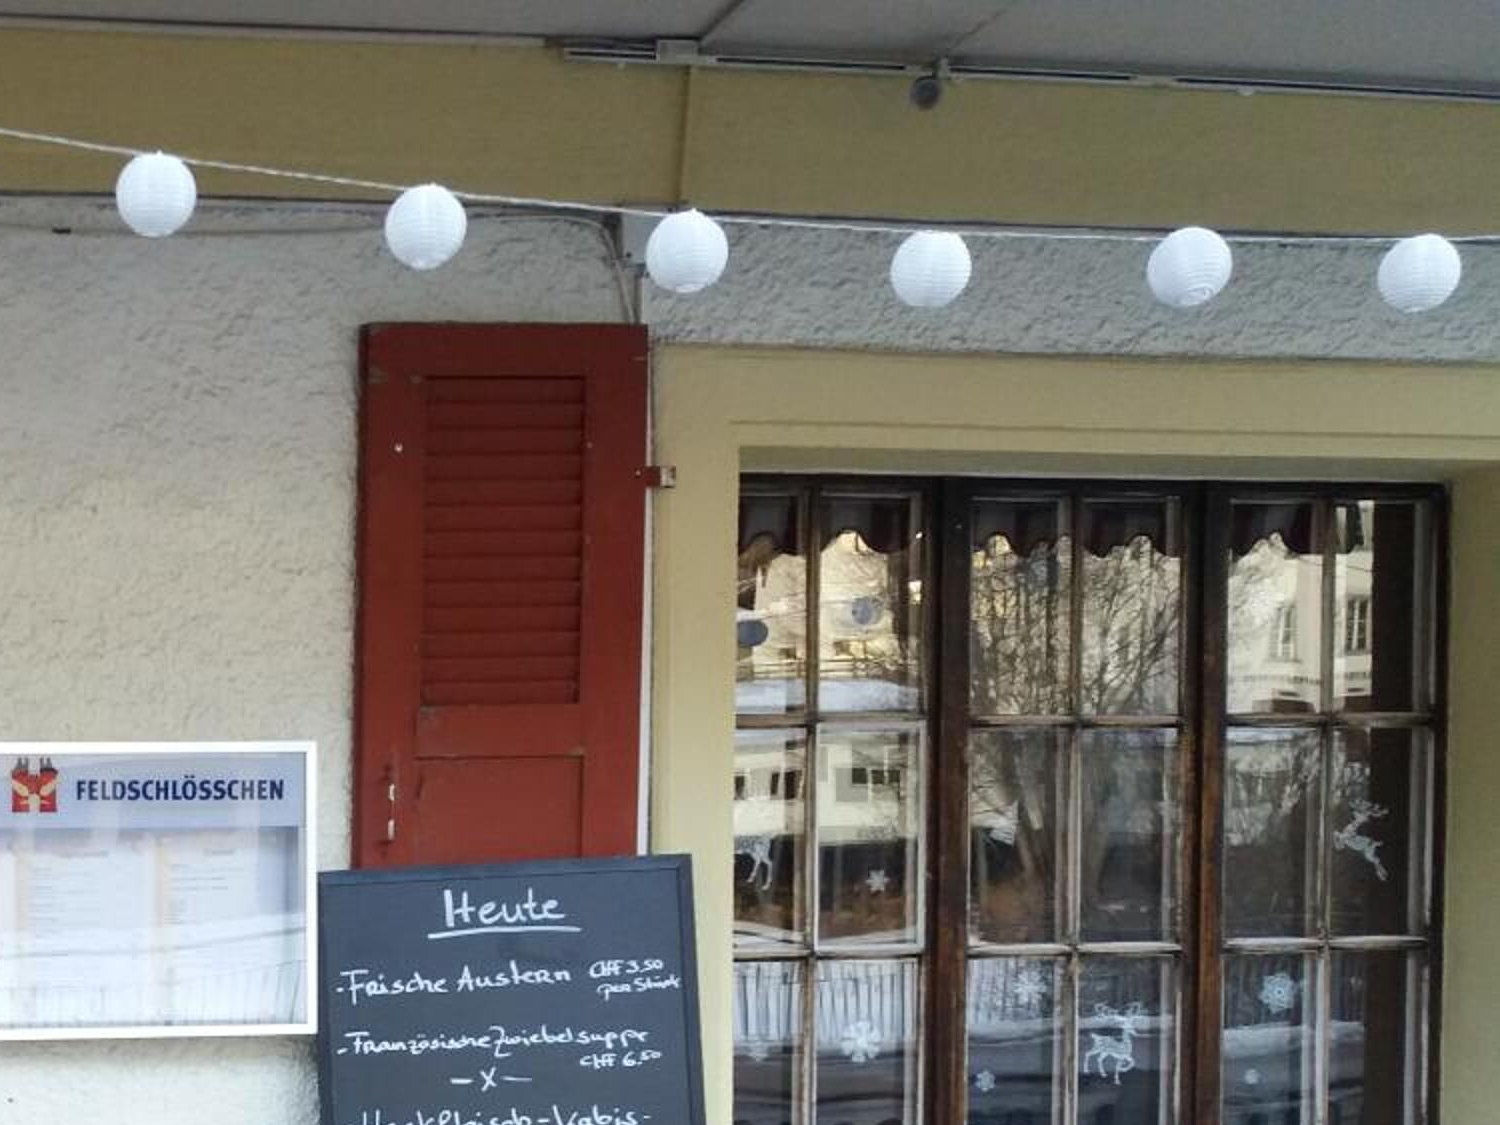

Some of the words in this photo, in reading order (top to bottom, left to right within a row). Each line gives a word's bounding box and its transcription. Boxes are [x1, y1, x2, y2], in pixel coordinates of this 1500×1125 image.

[76, 774, 285, 801] FELDSCHLÖSSCHEN
[443, 887, 566, 928] Heute
[456, 960, 572, 993] Austern
[589, 960, 624, 978] CHF
